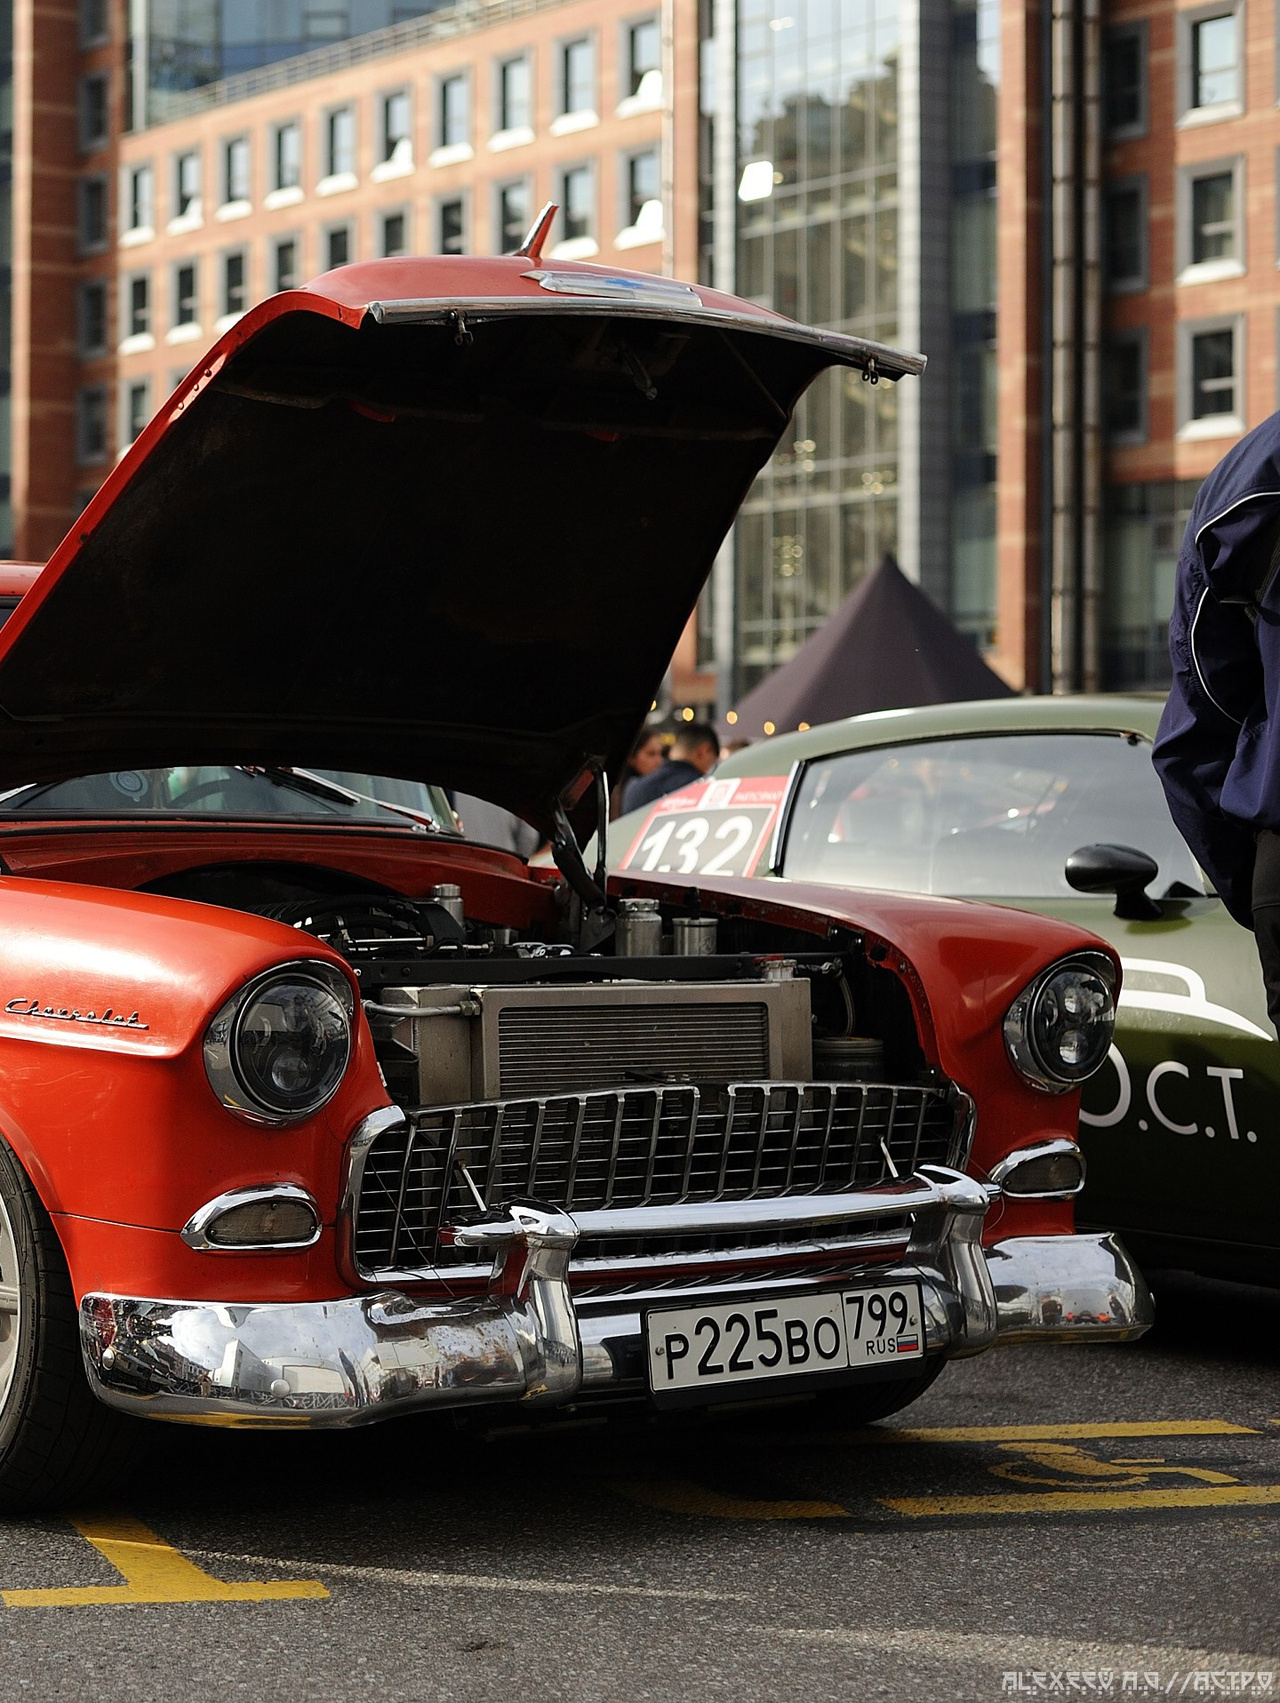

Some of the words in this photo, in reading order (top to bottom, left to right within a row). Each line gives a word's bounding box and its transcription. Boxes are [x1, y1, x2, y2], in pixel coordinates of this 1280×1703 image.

[641, 815, 753, 877] 132
[5, 998, 150, 1031] Chevrolet
[664, 1308, 841, 1380] P225BO
[845, 1291, 909, 1340] 799
[866, 1337, 896, 1356] RUS
